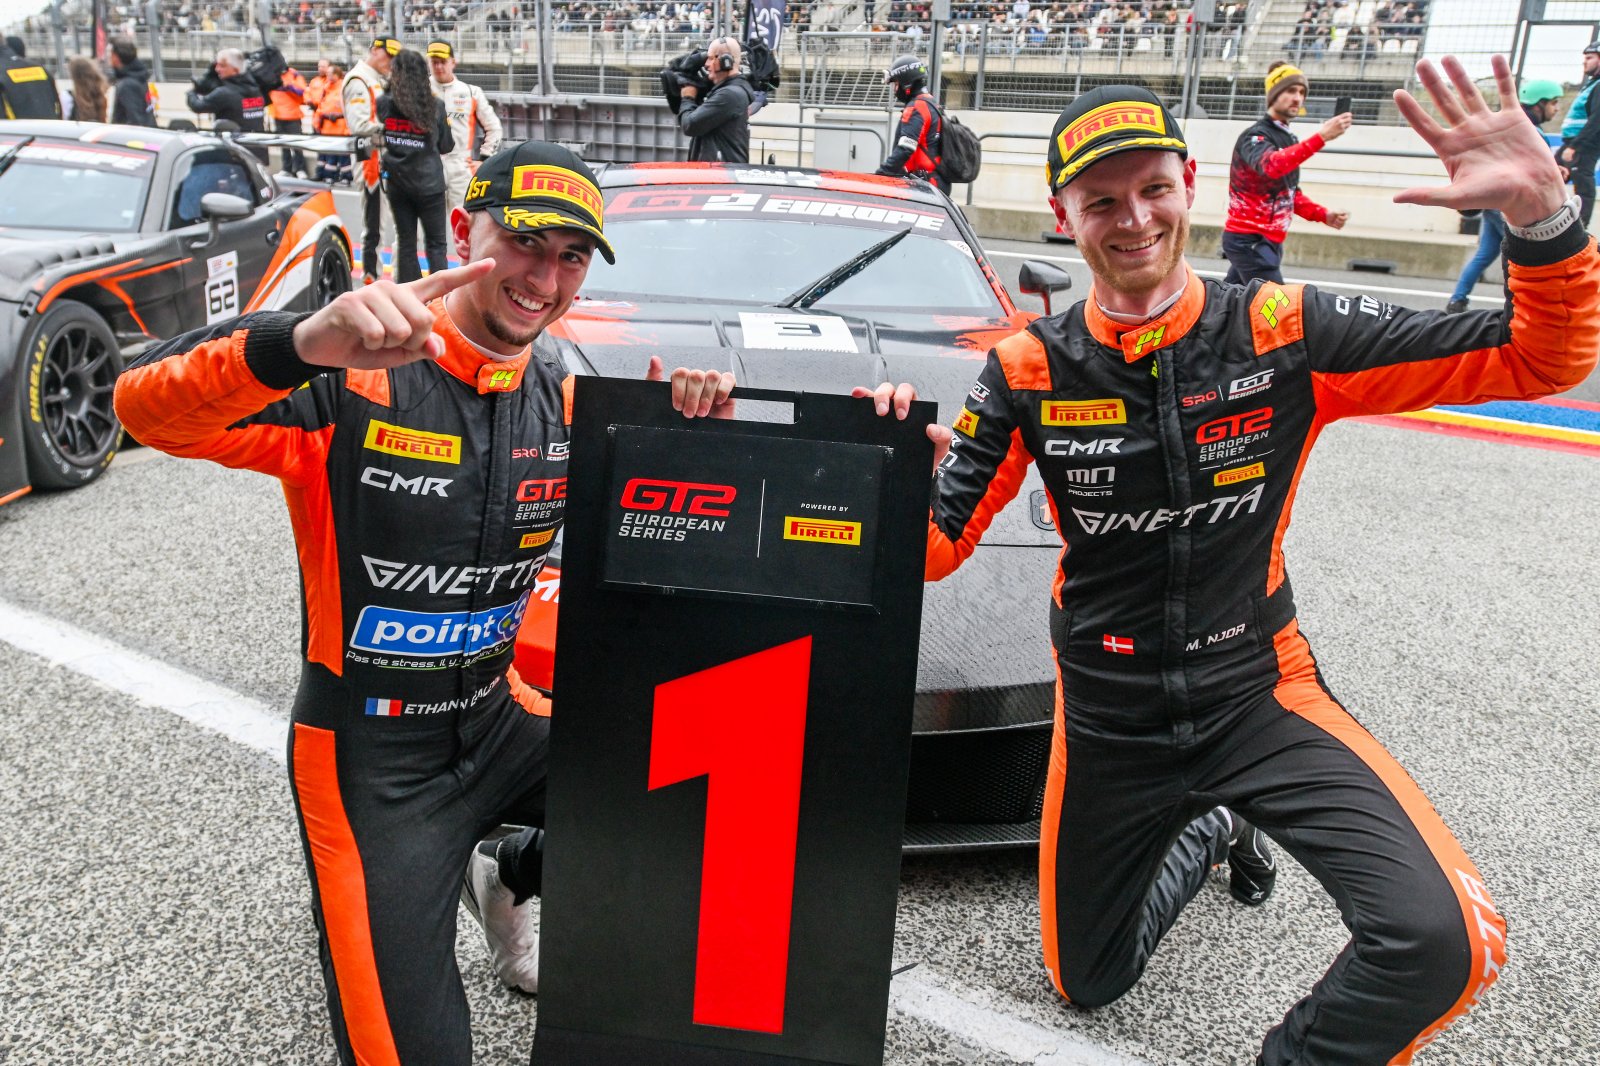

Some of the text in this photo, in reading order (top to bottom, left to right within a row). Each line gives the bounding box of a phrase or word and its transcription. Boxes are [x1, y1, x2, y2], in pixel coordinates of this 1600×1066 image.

[1064, 106, 1157, 152] PIRELLI
[385, 135, 425, 149] TELEVISION
[466, 176, 491, 202] 1ST
[521, 171, 603, 217] PIRELLI
[761, 198, 945, 232] EUROPE
[1182, 391, 1217, 407] SRO
[1050, 402, 1118, 422] PIRELLI
[1195, 406, 1274, 445] GT2
[375, 427, 453, 458] PIRELLI
[1044, 437, 1125, 456] CMR
[1200, 430, 1269, 453] EUROPEAN
[512, 448, 538, 459] SRO
[1199, 446, 1246, 462] SERIES
[360, 466, 454, 498] CMR
[1217, 465, 1260, 483] PIRELLI
[620, 478, 737, 517] GT2
[1068, 488, 1113, 497] PROJECTS
[514, 510, 552, 521] SERIES
[518, 500, 566, 512] EUROPEA
[800, 502, 836, 511] POWERED
[1071, 482, 1266, 535] GINETTA
[622, 512, 726, 532] EUROPEAN
[790, 520, 855, 541] PIRELLI
[618, 525, 687, 542] SERIES
[361, 553, 548, 595] GINETTA
[371, 615, 493, 645] point
[346, 650, 369, 664] Pas
[373, 656, 389, 665] de
[404, 698, 469, 715] ETHANN
[648, 634, 813, 1035] 1
